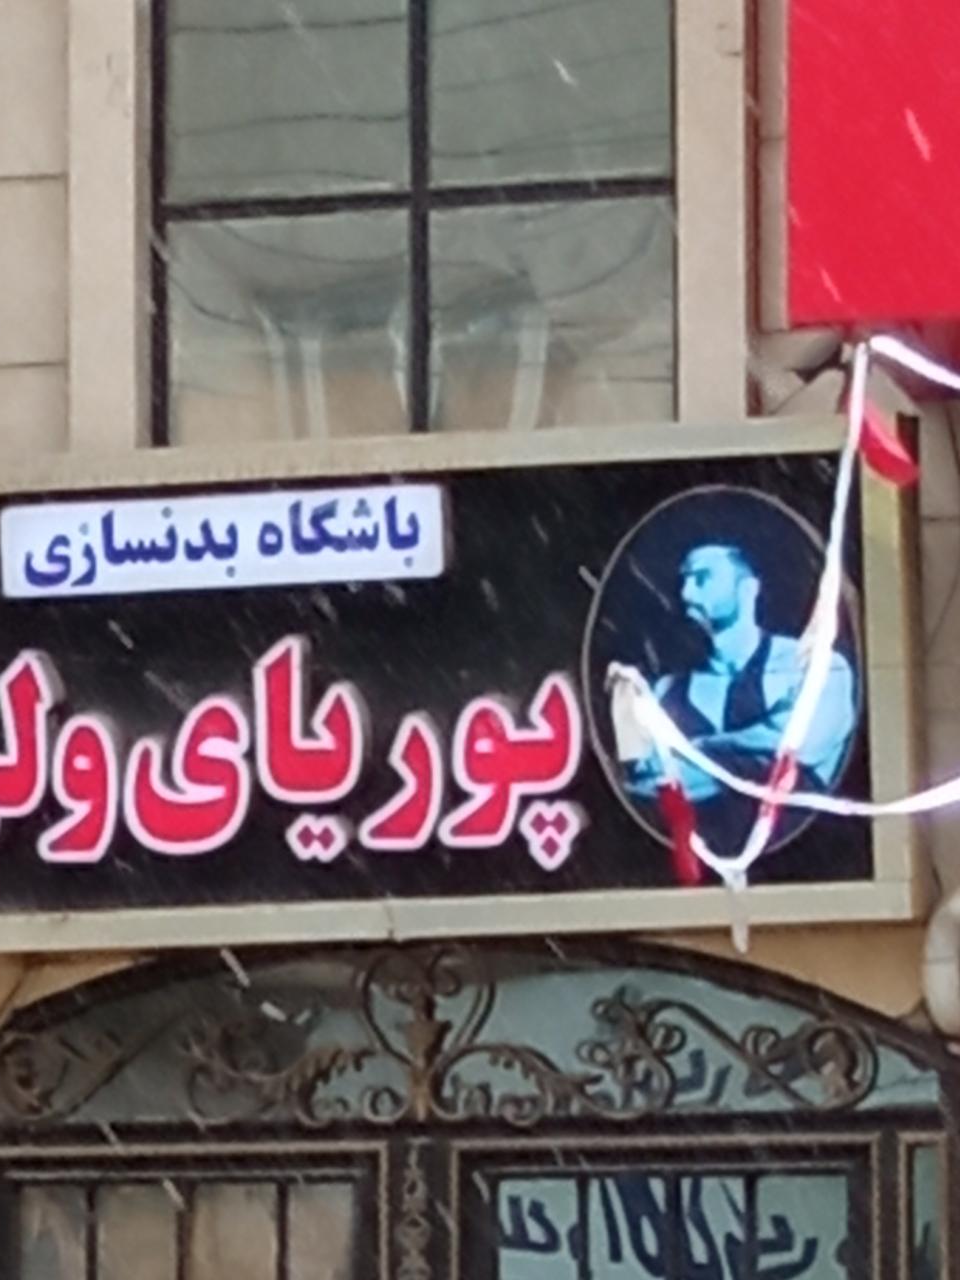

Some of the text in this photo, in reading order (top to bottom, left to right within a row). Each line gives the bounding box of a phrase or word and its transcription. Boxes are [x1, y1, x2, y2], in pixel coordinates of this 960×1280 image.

[24, 496, 421, 587] باشگاه بدنسازی
[124, 635, 583, 871] پوریای
